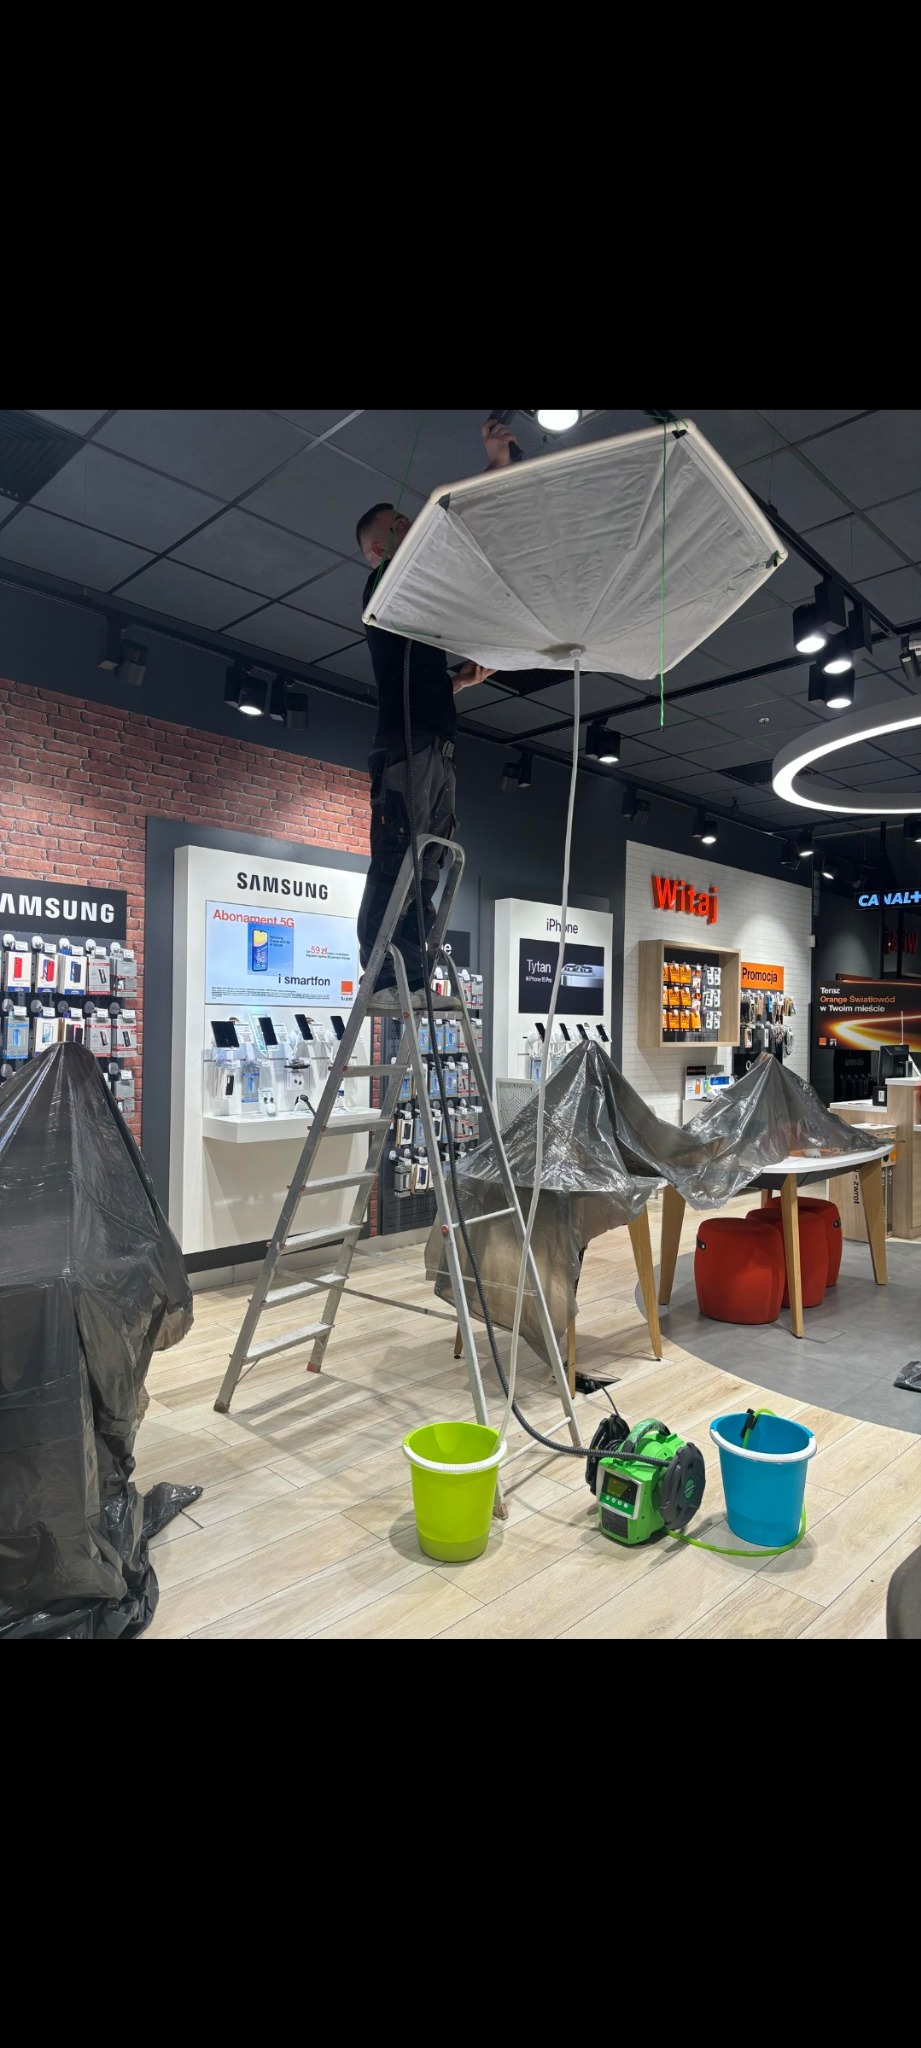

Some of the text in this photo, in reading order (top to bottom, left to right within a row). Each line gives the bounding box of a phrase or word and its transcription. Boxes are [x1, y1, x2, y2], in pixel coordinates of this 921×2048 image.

[236, 872, 329, 900] SAMSUNG
[651, 875, 719, 925] Witaj
[858, 890, 921, 907] CANAL+
[0, 892, 115, 924] AMSUNG
[213, 909, 295, 929] Abonament 5G
[546, 918, 579, 934] iPhne
[311, 945, 321, 954] 59
[321, 947, 328, 955] zł
[526, 959, 552, 975] Tytan
[278, 974, 331, 987] i smartfon
[742, 967, 778, 984] Promocja
[820, 994, 896, 1004] Orange Światłowód
[828, 1004, 853, 1012] Twoim
[854, 1004, 886, 1012] mieście
